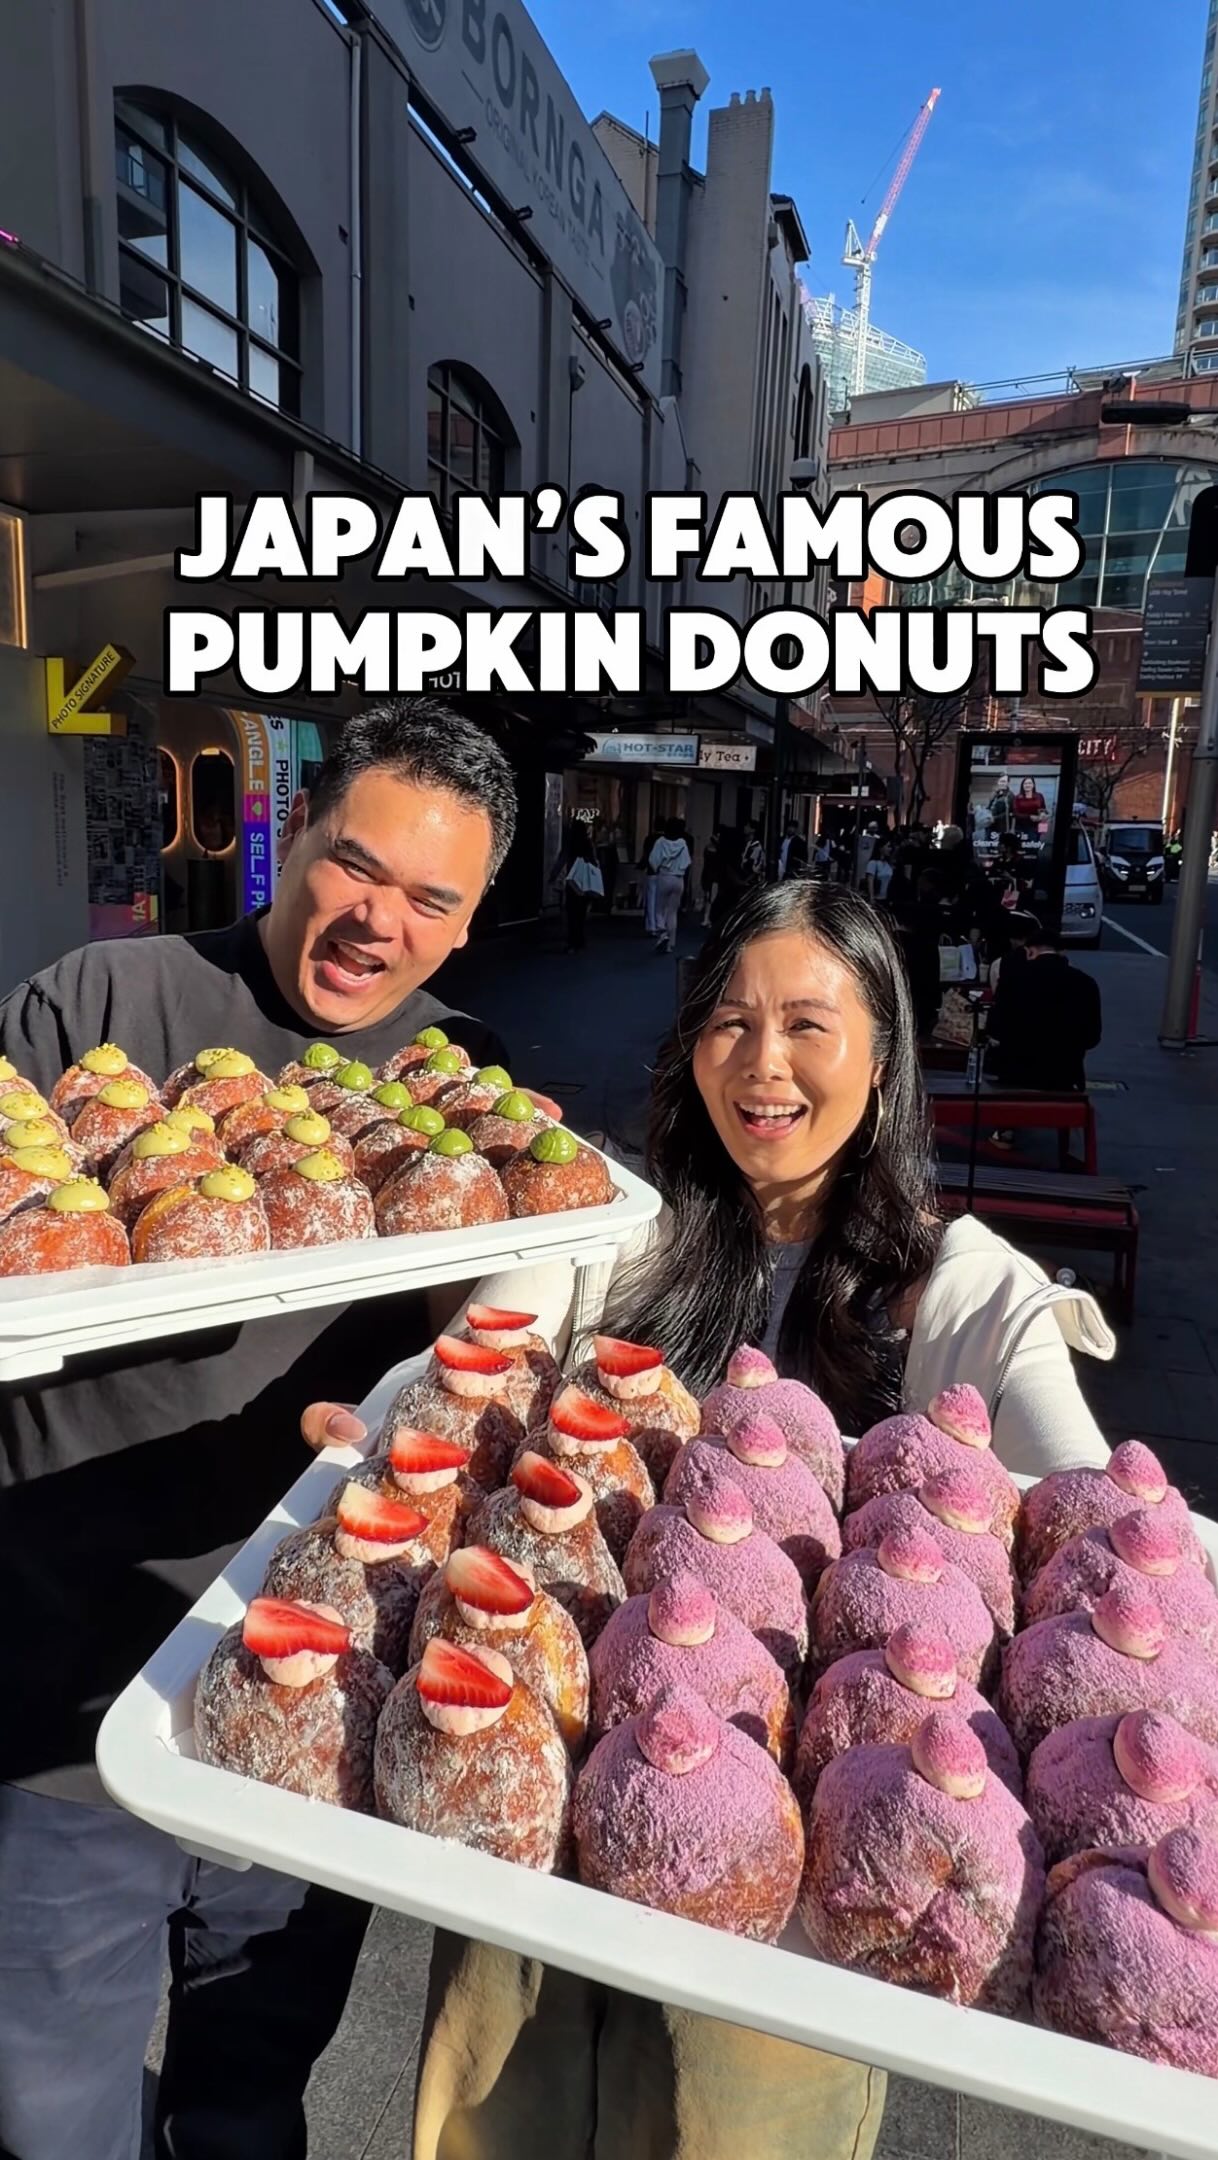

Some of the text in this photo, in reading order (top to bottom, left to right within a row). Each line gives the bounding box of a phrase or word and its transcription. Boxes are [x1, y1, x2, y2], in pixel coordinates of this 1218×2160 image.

[51, 651, 115, 729] PHOTO SIGNATURE
[623, 743, 694, 753] HOT-STAR
[715, 751, 741, 762] Tea
[1078, 740, 1112, 755] CITY
[276, 759, 290, 823] PHOTO
[250, 832, 265, 886] SELF
